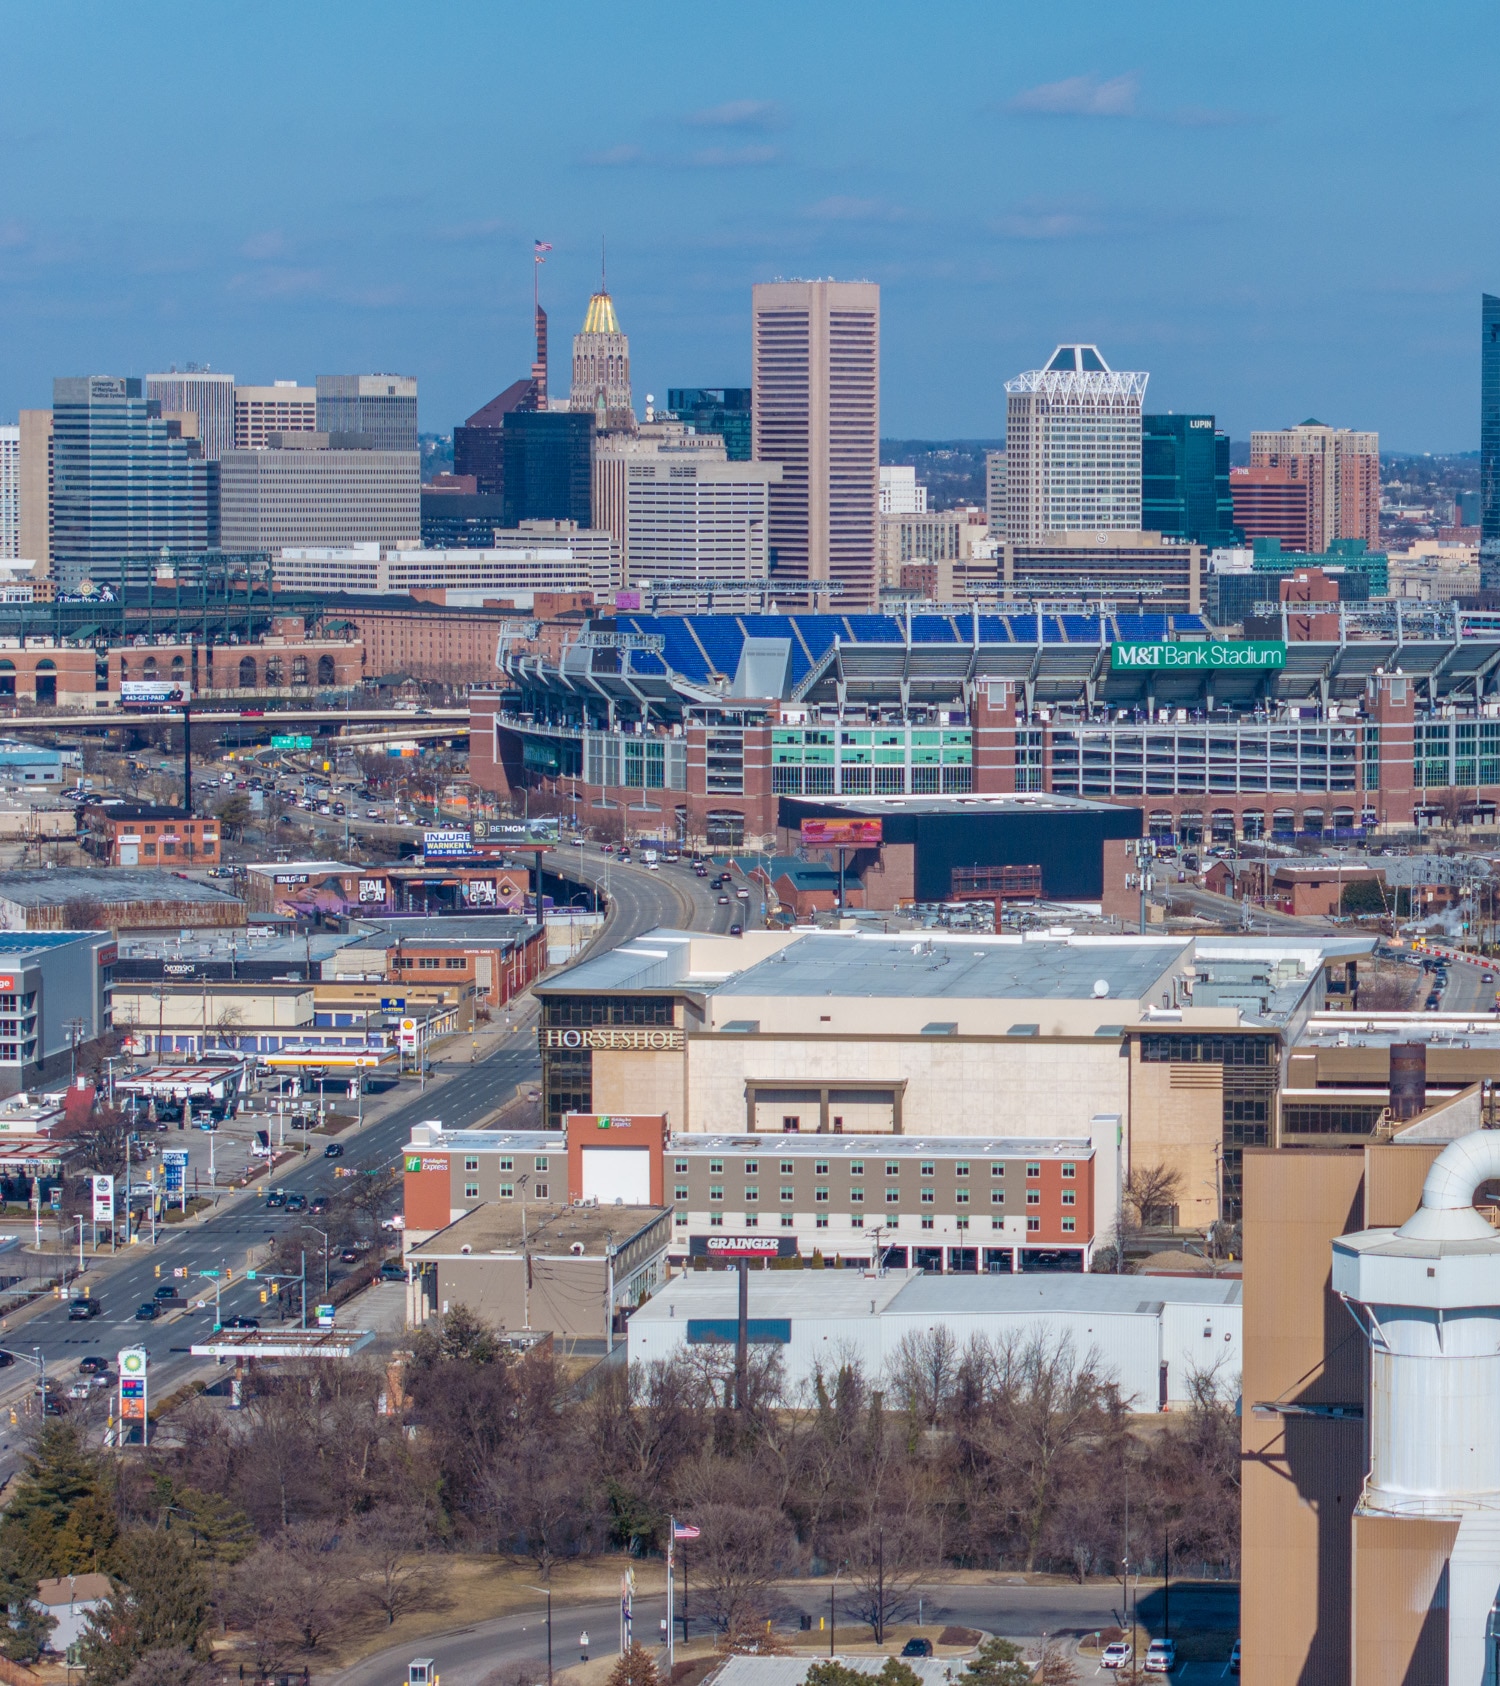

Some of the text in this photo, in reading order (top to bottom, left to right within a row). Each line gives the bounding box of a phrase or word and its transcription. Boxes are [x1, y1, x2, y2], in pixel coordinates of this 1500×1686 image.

[1190, 421, 1212, 429] LUPIN
[1117, 646, 1281, 665] M&T Bank Stadium
[427, 842, 465, 850] WARNKEN
[546, 1029, 679, 1048] HORSESHOE
[423, 1163, 448, 1171] Express
[708, 1237, 779, 1249] GRAINGER
